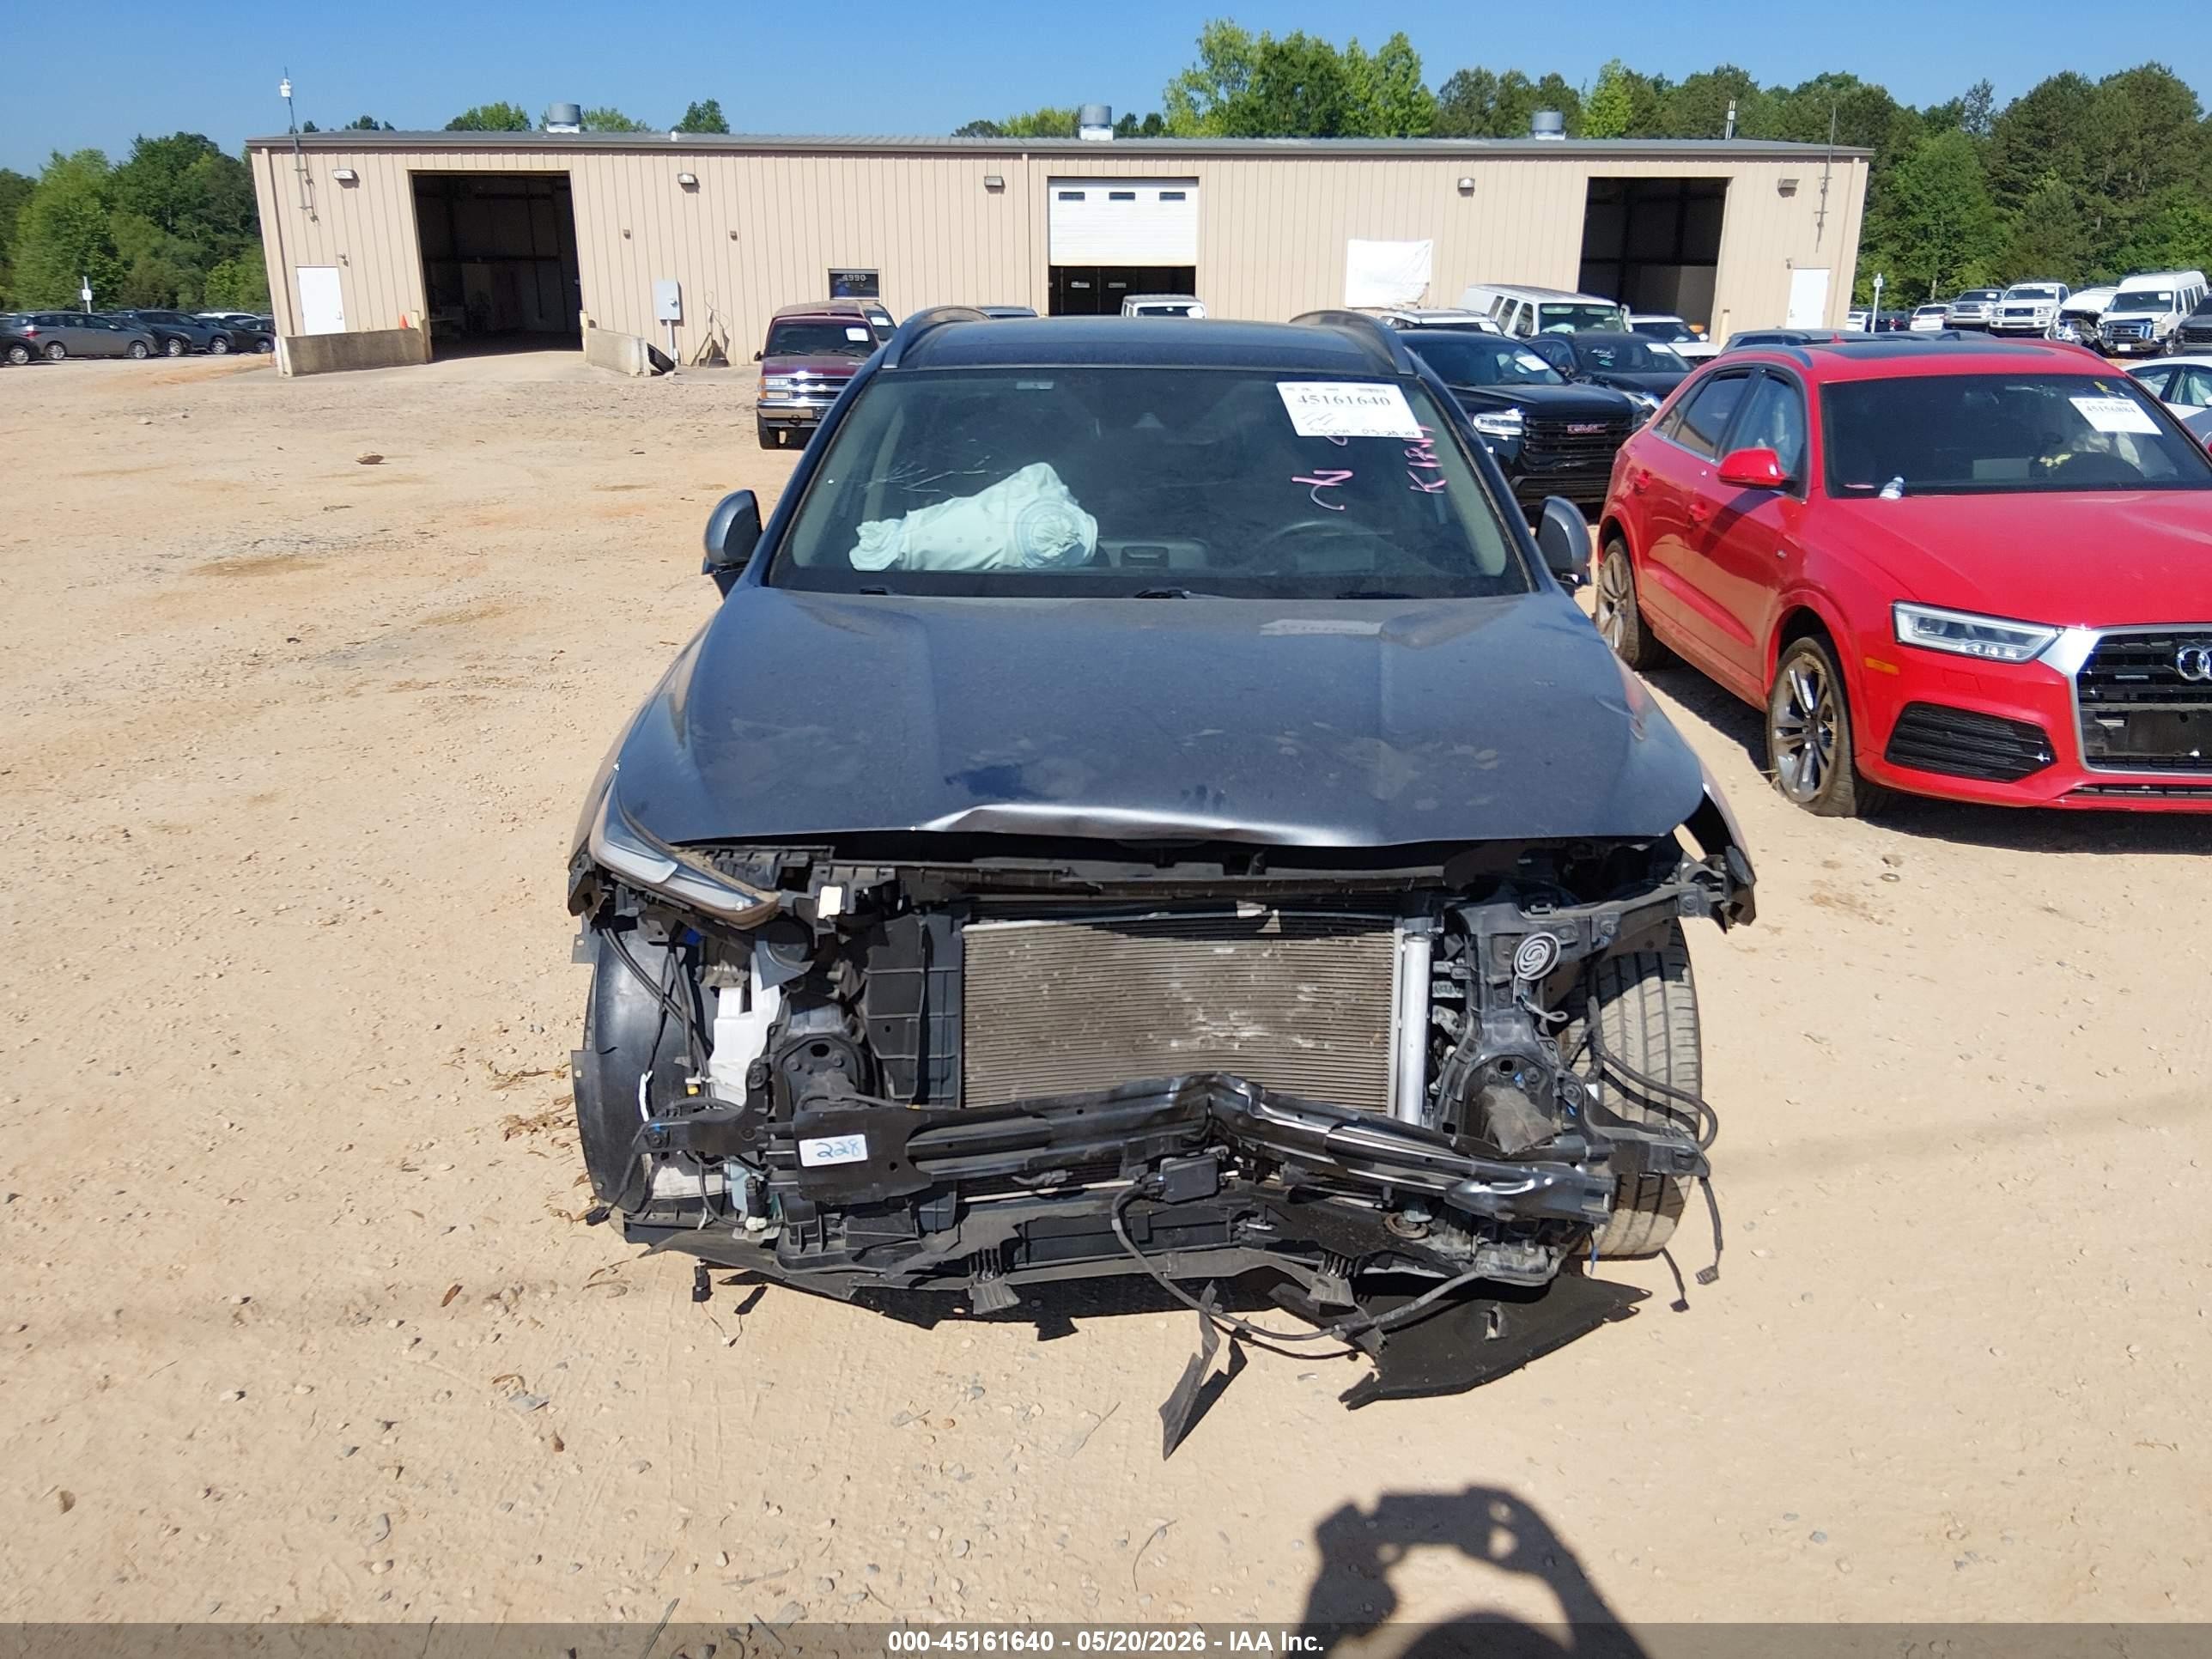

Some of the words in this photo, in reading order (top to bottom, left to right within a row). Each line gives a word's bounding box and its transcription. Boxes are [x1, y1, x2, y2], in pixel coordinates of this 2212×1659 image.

[1297, 394, 1391, 406] 45161640
[1567, 424, 1607, 434] GMC
[815, 1138, 862, 1158] 228
